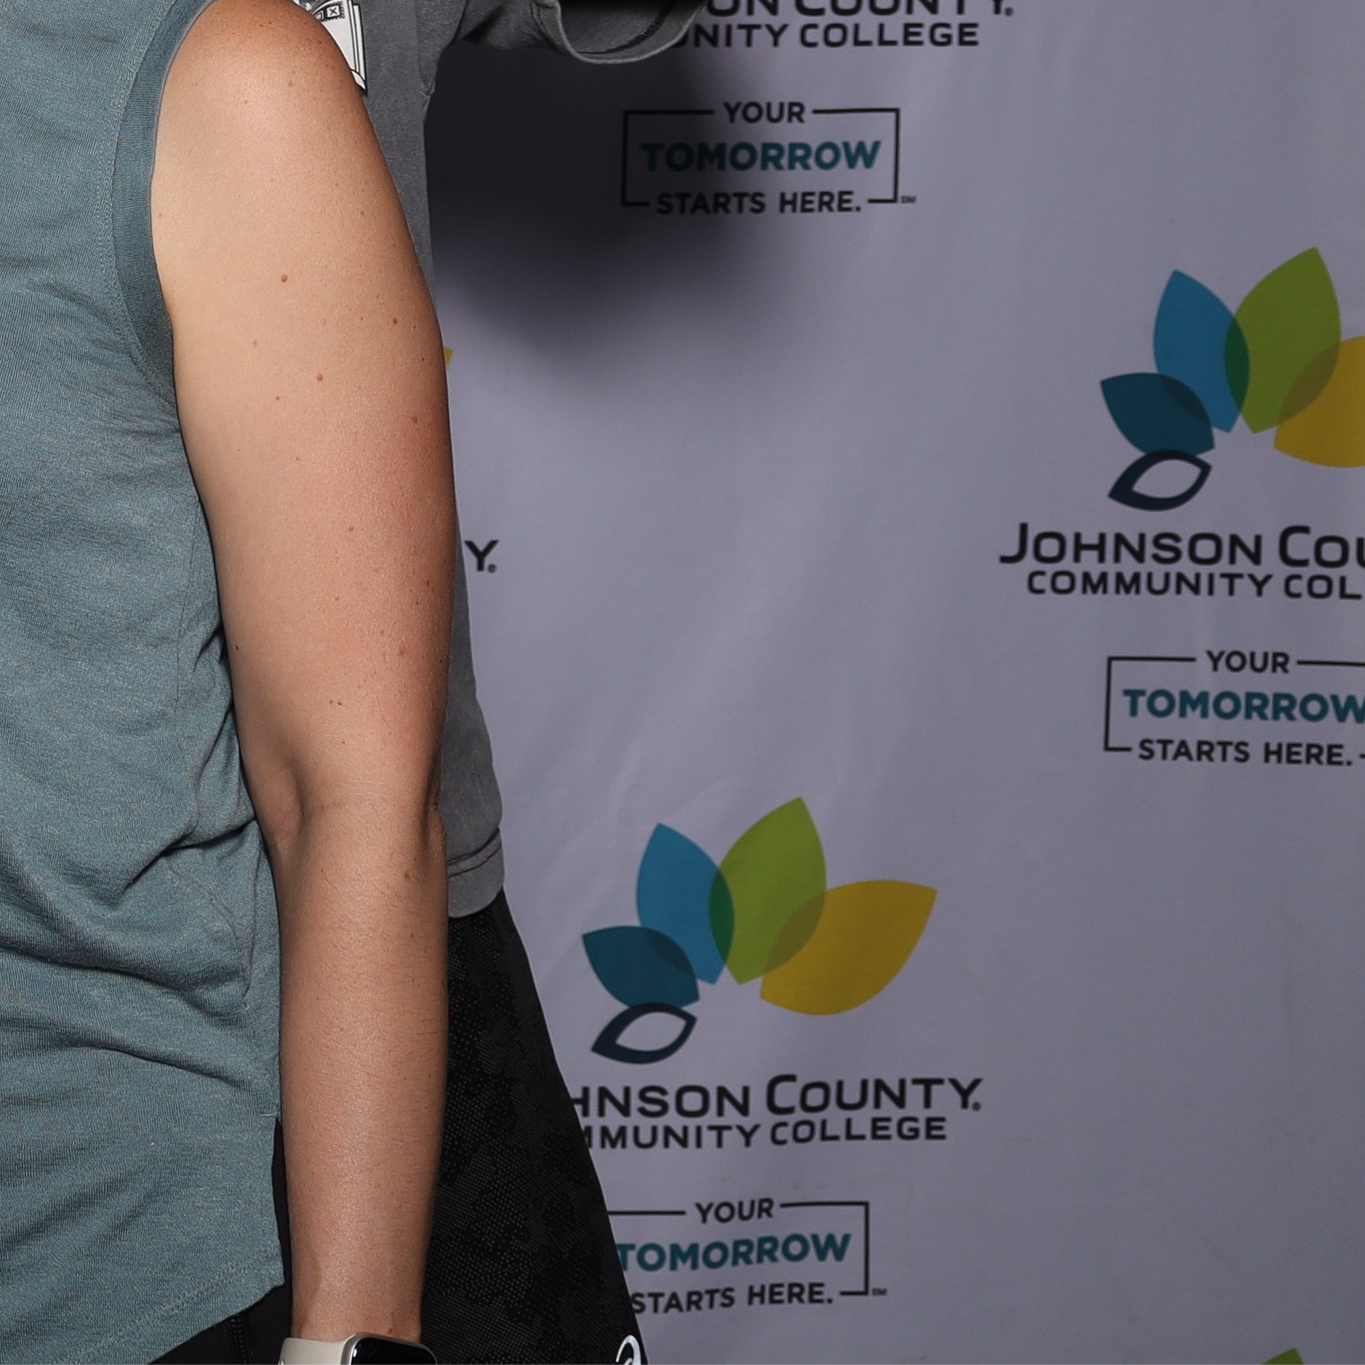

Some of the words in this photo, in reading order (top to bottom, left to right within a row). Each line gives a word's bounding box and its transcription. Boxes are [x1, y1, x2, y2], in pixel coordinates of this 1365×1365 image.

[799, 21, 979, 48] COLLEGE
[723, 101, 806, 124] YOUR
[641, 140, 881, 172] TOMORROW
[656, 191, 766, 215] STARTS
[779, 190, 862, 214] HERE.
[999, 522, 1262, 567] JOHNSON
[1027, 570, 1273, 597] COMMUNITY
[1206, 650, 1290, 674] YOUR
[1122, 688, 1365, 725] TOMORROW
[1139, 738, 1251, 764] STARTS
[1264, 742, 1352, 767] HERE.
[569, 1084, 751, 1119] HNSON
[581, 1123, 761, 1150] MUNITY
[771, 1116, 948, 1146] COLLEGE
[695, 1198, 775, 1224] YOUR
[616, 1233, 851, 1272] TOMORROW
[630, 1287, 735, 1315] STARTS
[747, 1282, 833, 1307] HERE.
